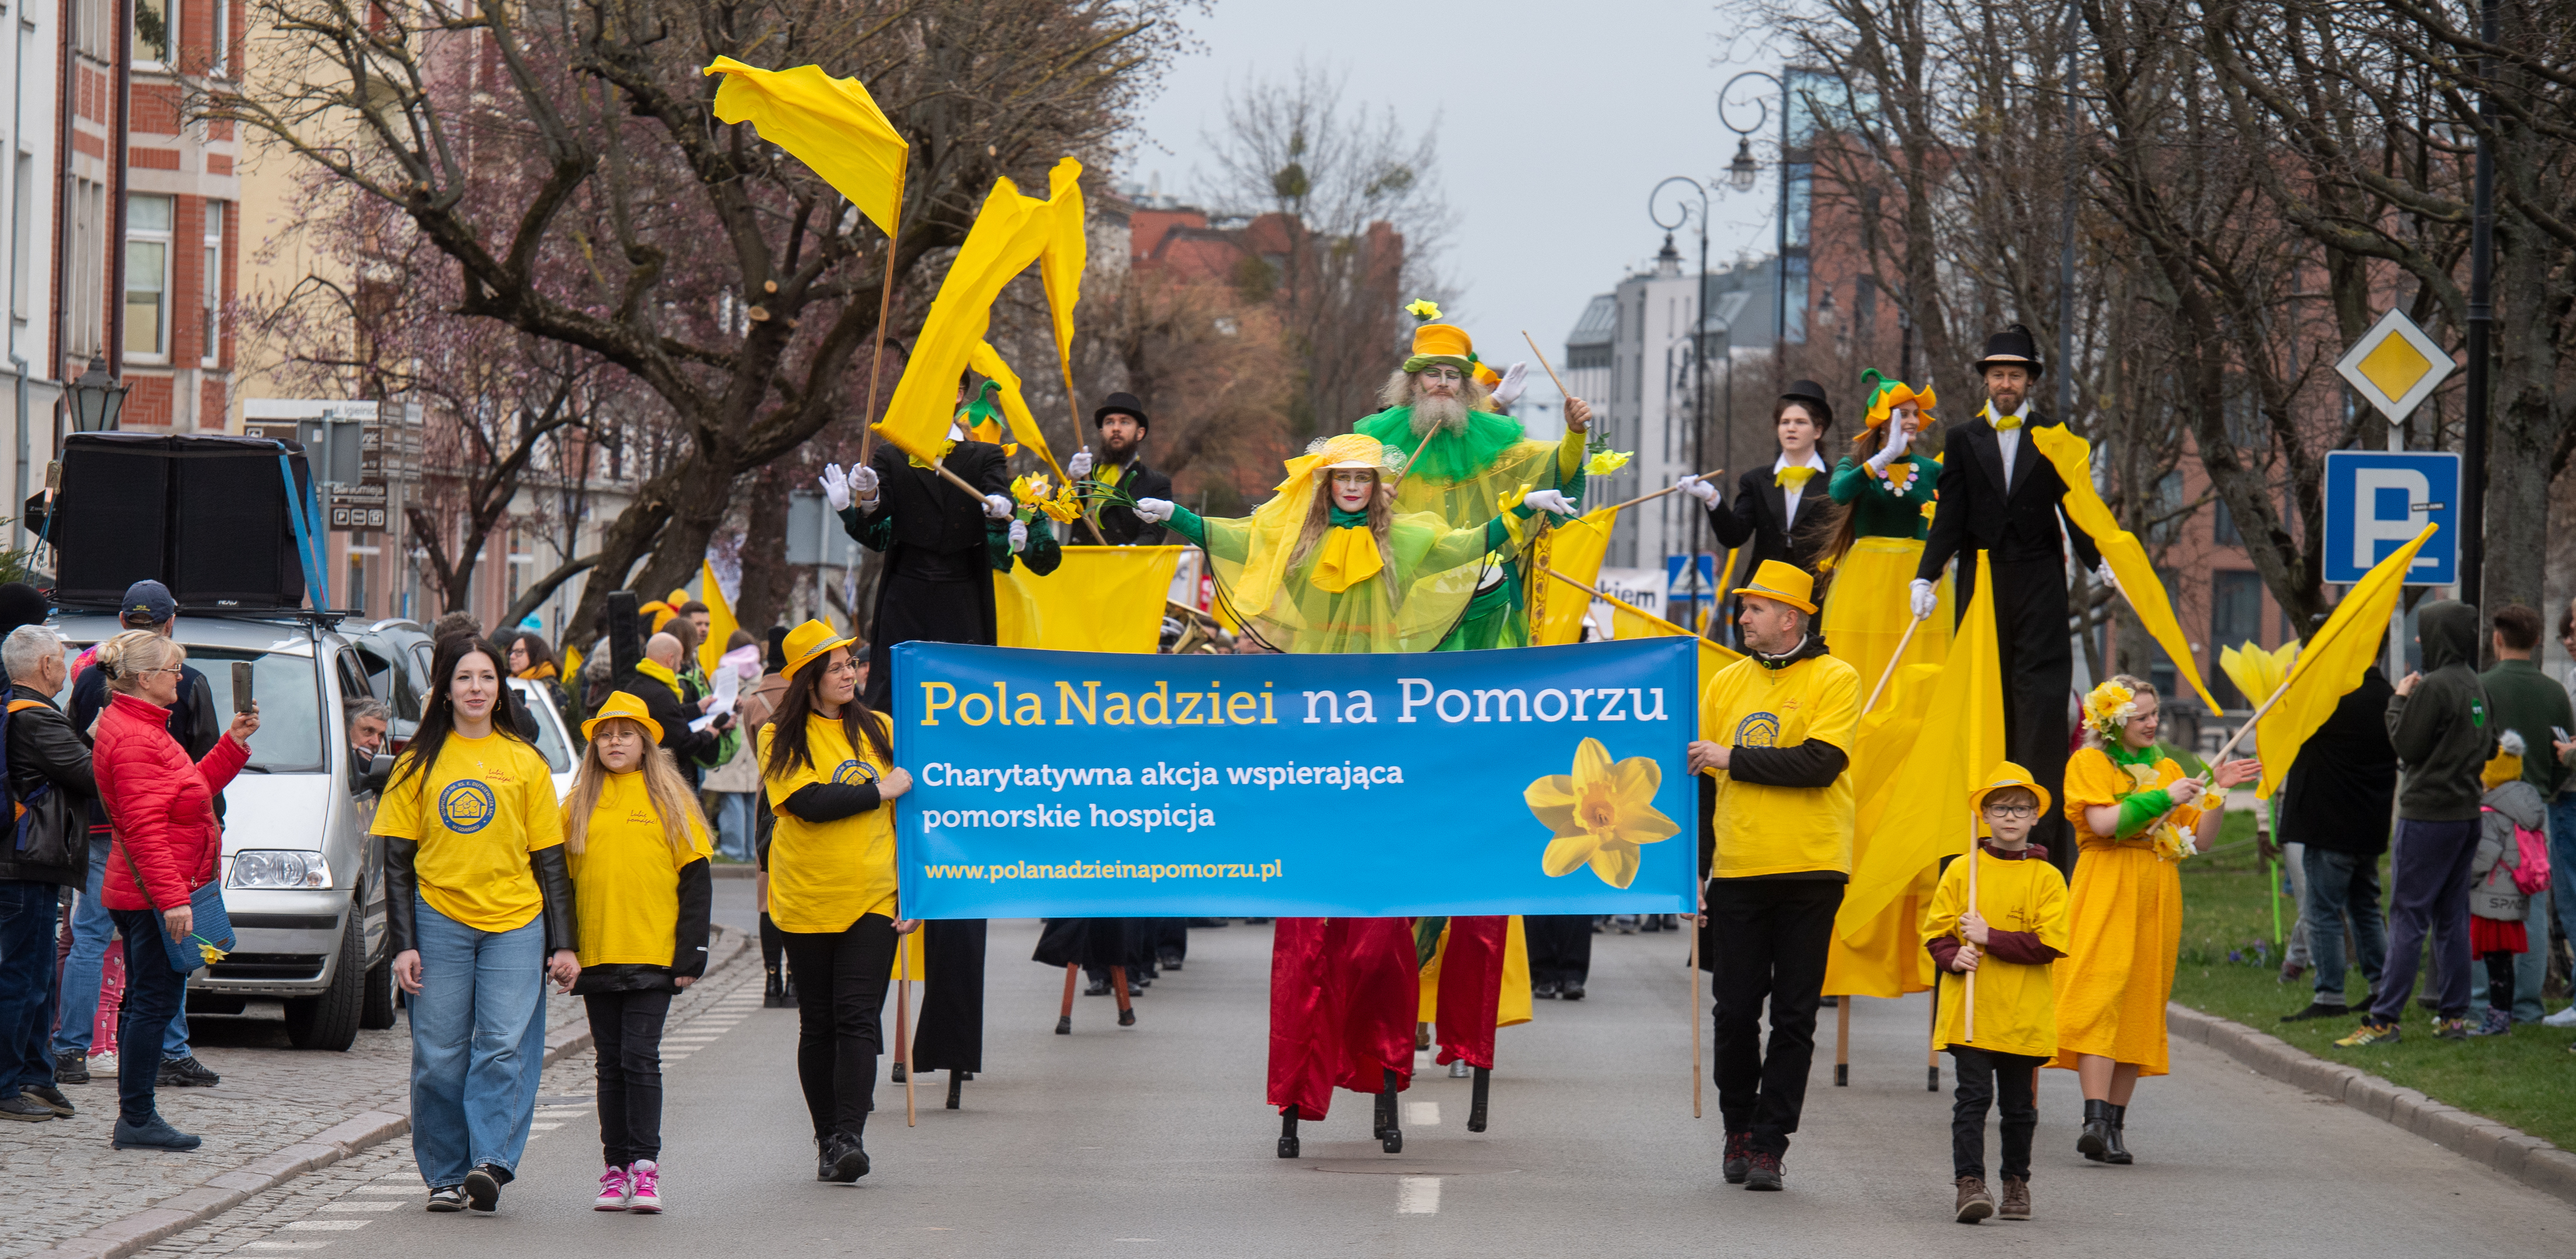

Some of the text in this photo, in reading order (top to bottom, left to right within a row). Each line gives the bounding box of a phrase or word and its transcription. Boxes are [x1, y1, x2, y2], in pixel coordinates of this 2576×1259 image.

[2353, 468, 2430, 569] P
[920, 678, 1668, 726] Pola Nadziei na Pomorzu
[922, 760, 1404, 792] Charytatywna akcja wspierająca
[471, 782, 494, 807] DUTKIEWICZA
[458, 824, 480, 833] GDAŃSKU
[922, 802, 1216, 833] pomorskie hospicja
[924, 859, 1283, 884] www.polanadzieinapomorzu.pl
